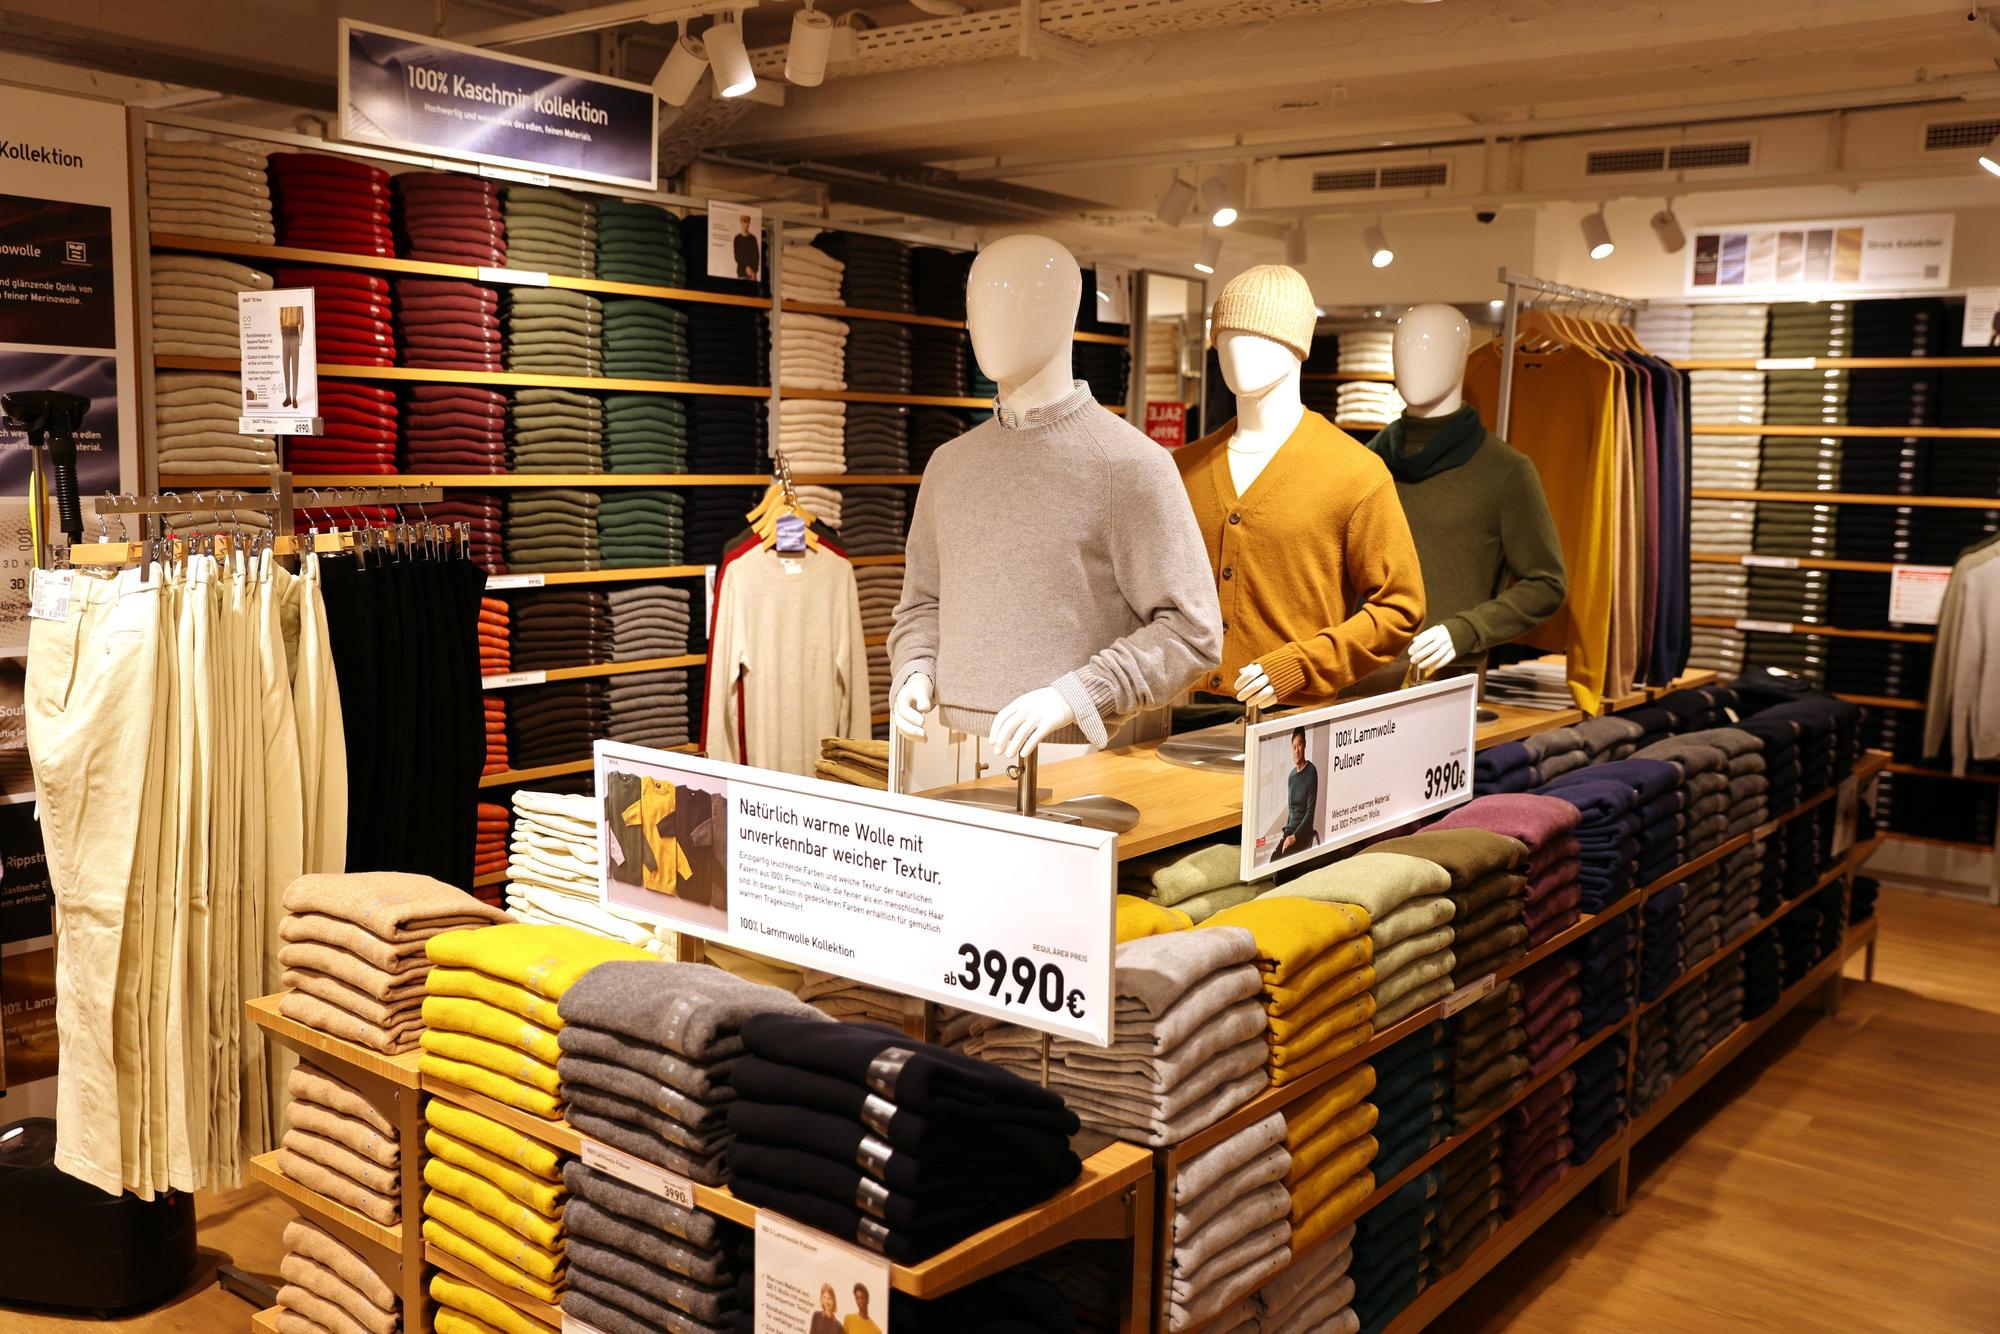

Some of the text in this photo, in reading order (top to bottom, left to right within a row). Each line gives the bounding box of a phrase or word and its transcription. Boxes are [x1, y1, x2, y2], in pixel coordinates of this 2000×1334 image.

[408, 64, 608, 126] 100% Kaschmir Kollektion
[424, 102, 463, 119] Hochwertig
[464, 110, 477, 120] und
[514, 119, 525, 129] des
[525, 121, 544, 133] edlen,
[545, 125, 564, 136] feinen
[564, 128, 592, 142] Materials.
[0, 140, 83, 168] Kollektion
[4, 291, 28, 301] feiner
[31, 293, 83, 305] Merinowolle.
[12, 278, 54, 291] glänzende
[55, 282, 77, 293] Optik
[78, 285, 93, 293] von
[10, 578, 25, 590] 3D
[1335, 720, 1396, 748] 100% Lammwolle
[1334, 752, 1365, 772] Pullover
[1424, 760, 1466, 800] 39,90€
[1332, 792, 1391, 819] Weiches und warmes Material
[740, 798, 923, 853] Natürlich warme Wolle mit
[1331, 824, 1339, 832] aus
[1340, 819, 1349, 829] 100%
[1350, 814, 1368, 826] Premium
[6, 855, 47, 868] Rippstr
[740, 826, 942, 885] unverkennbar weicher Textur.
[739, 851, 933, 904] Einzigartig leuchtende Farben und weiche Textur der natürlichen
[739, 863, 759, 874] Fasern
[760, 870, 770, 878] aus
[771, 871, 783, 881] 100%
[785, 874, 812, 888] Premium
[833, 886, 843, 896] die
[844, 889, 862, 900] feiner
[863, 895, 872, 903] als
[874, 897, 883, 906] ein
[884, 899, 927, 916] menschliches
[928, 909, 945, 920] Haar
[739, 890, 804, 912] warmen Tragekomfort.
[753, 879, 759, 887] In
[760, 881, 777, 892] dieser
[778, 885, 796, 897] Saison
[804, 893, 842, 908] gedeckteren
[843, 901, 865, 914] Farben
[866, 907, 896, 922] erhältlich
[897, 915, 907, 925] für
[909, 918, 941, 933] gemütlich
[740, 916, 855, 958] 100% Lammwolle Kollektion
[1032, 943, 1088, 963] REGULÄRER PREIS
[943, 943, 1086, 1019] ab 39,90€
